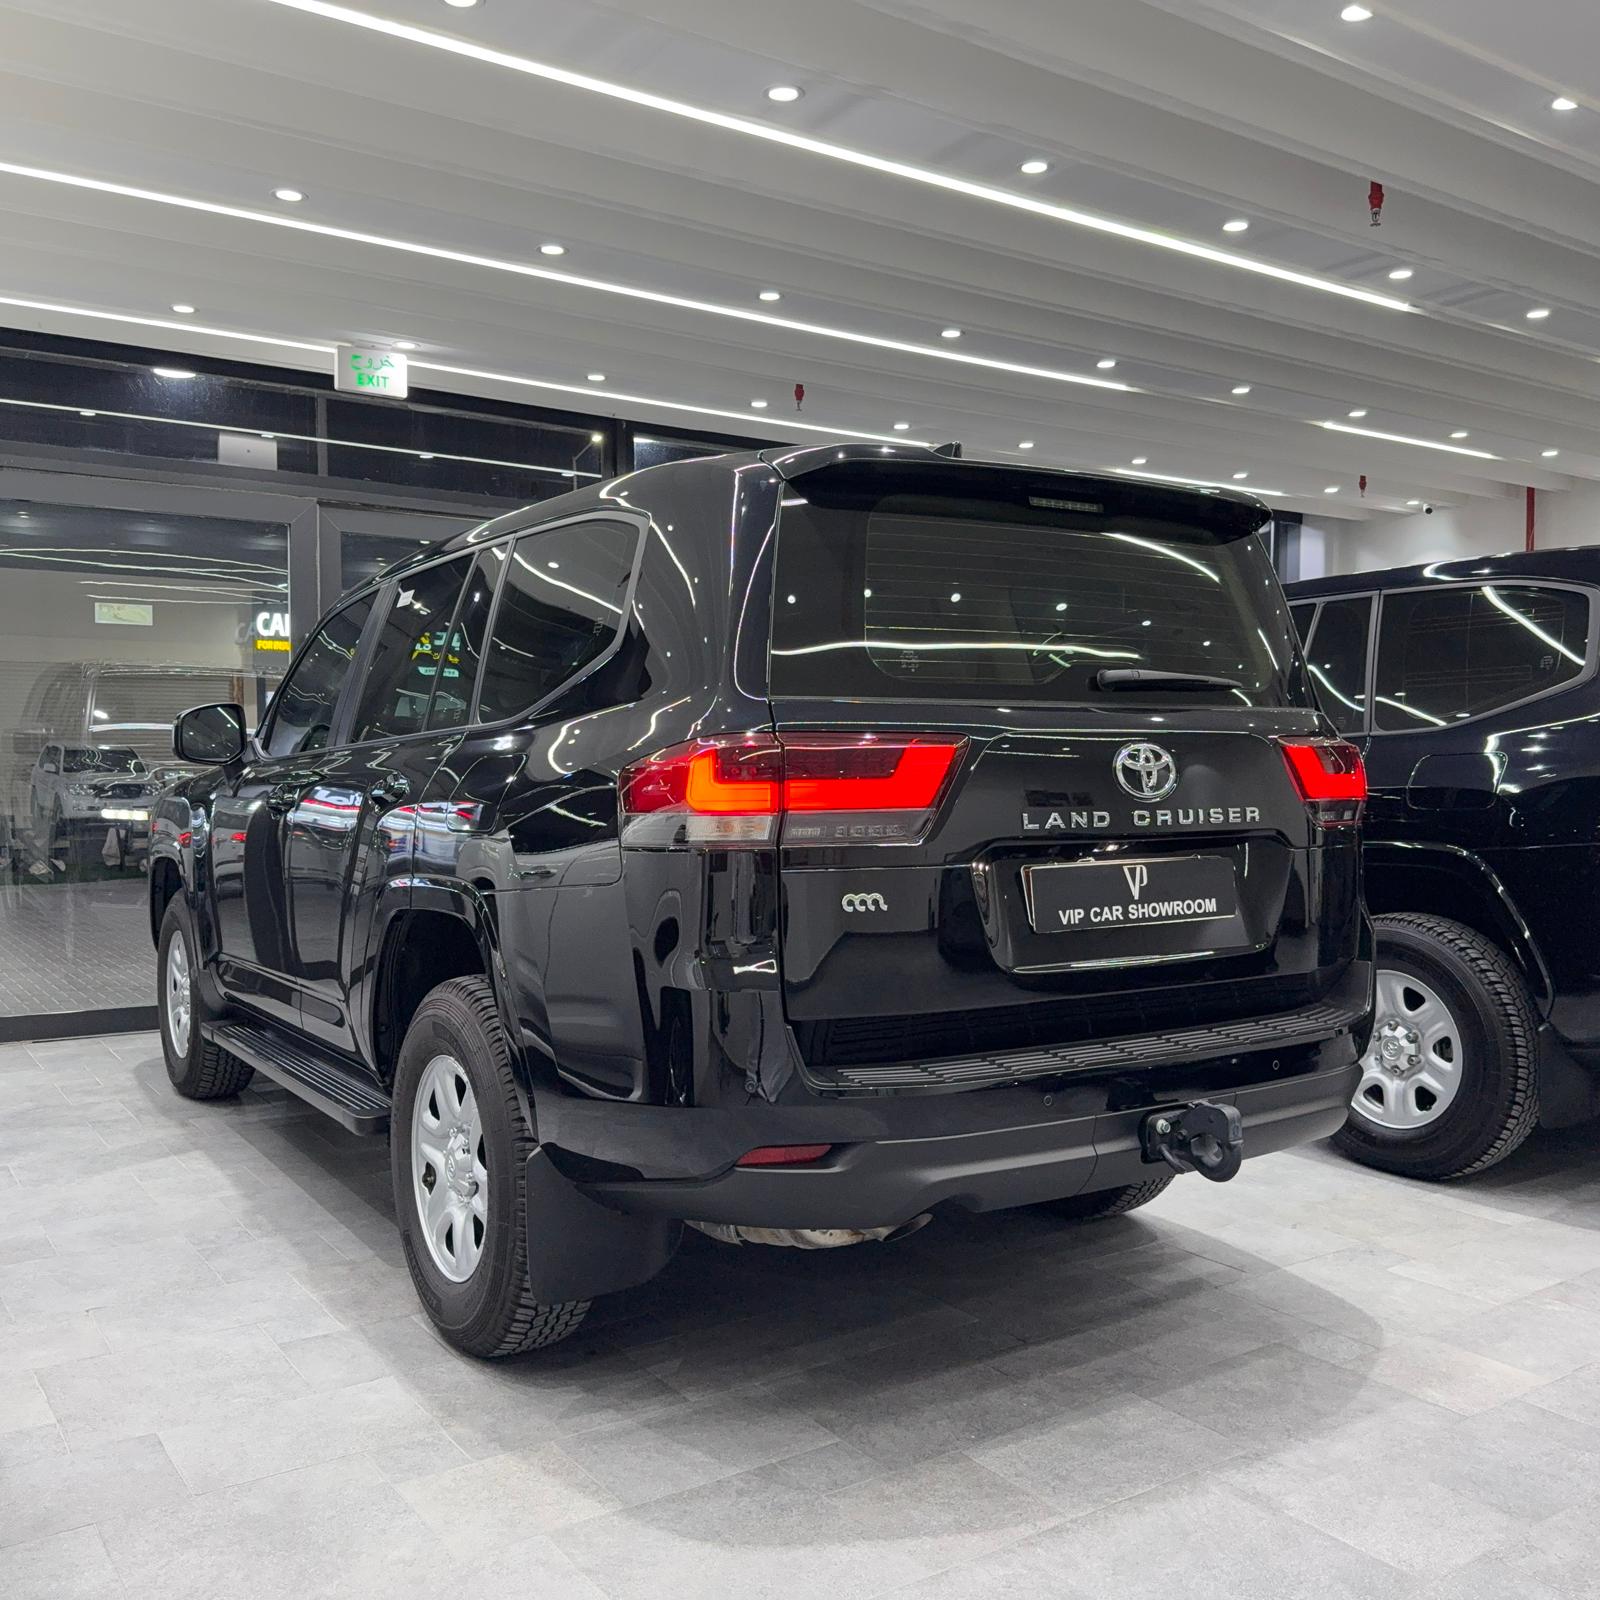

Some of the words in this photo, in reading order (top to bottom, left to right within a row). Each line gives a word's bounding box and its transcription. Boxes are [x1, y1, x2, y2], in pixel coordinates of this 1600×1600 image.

[356, 373, 390, 389] EXIT
[1022, 811, 1111, 830] LAND
[1133, 806, 1261, 826] CRUISER
[1058, 908, 1085, 926] VIP
[1090, 903, 1124, 922] CAR
[1128, 898, 1217, 920] SHOWROOM
